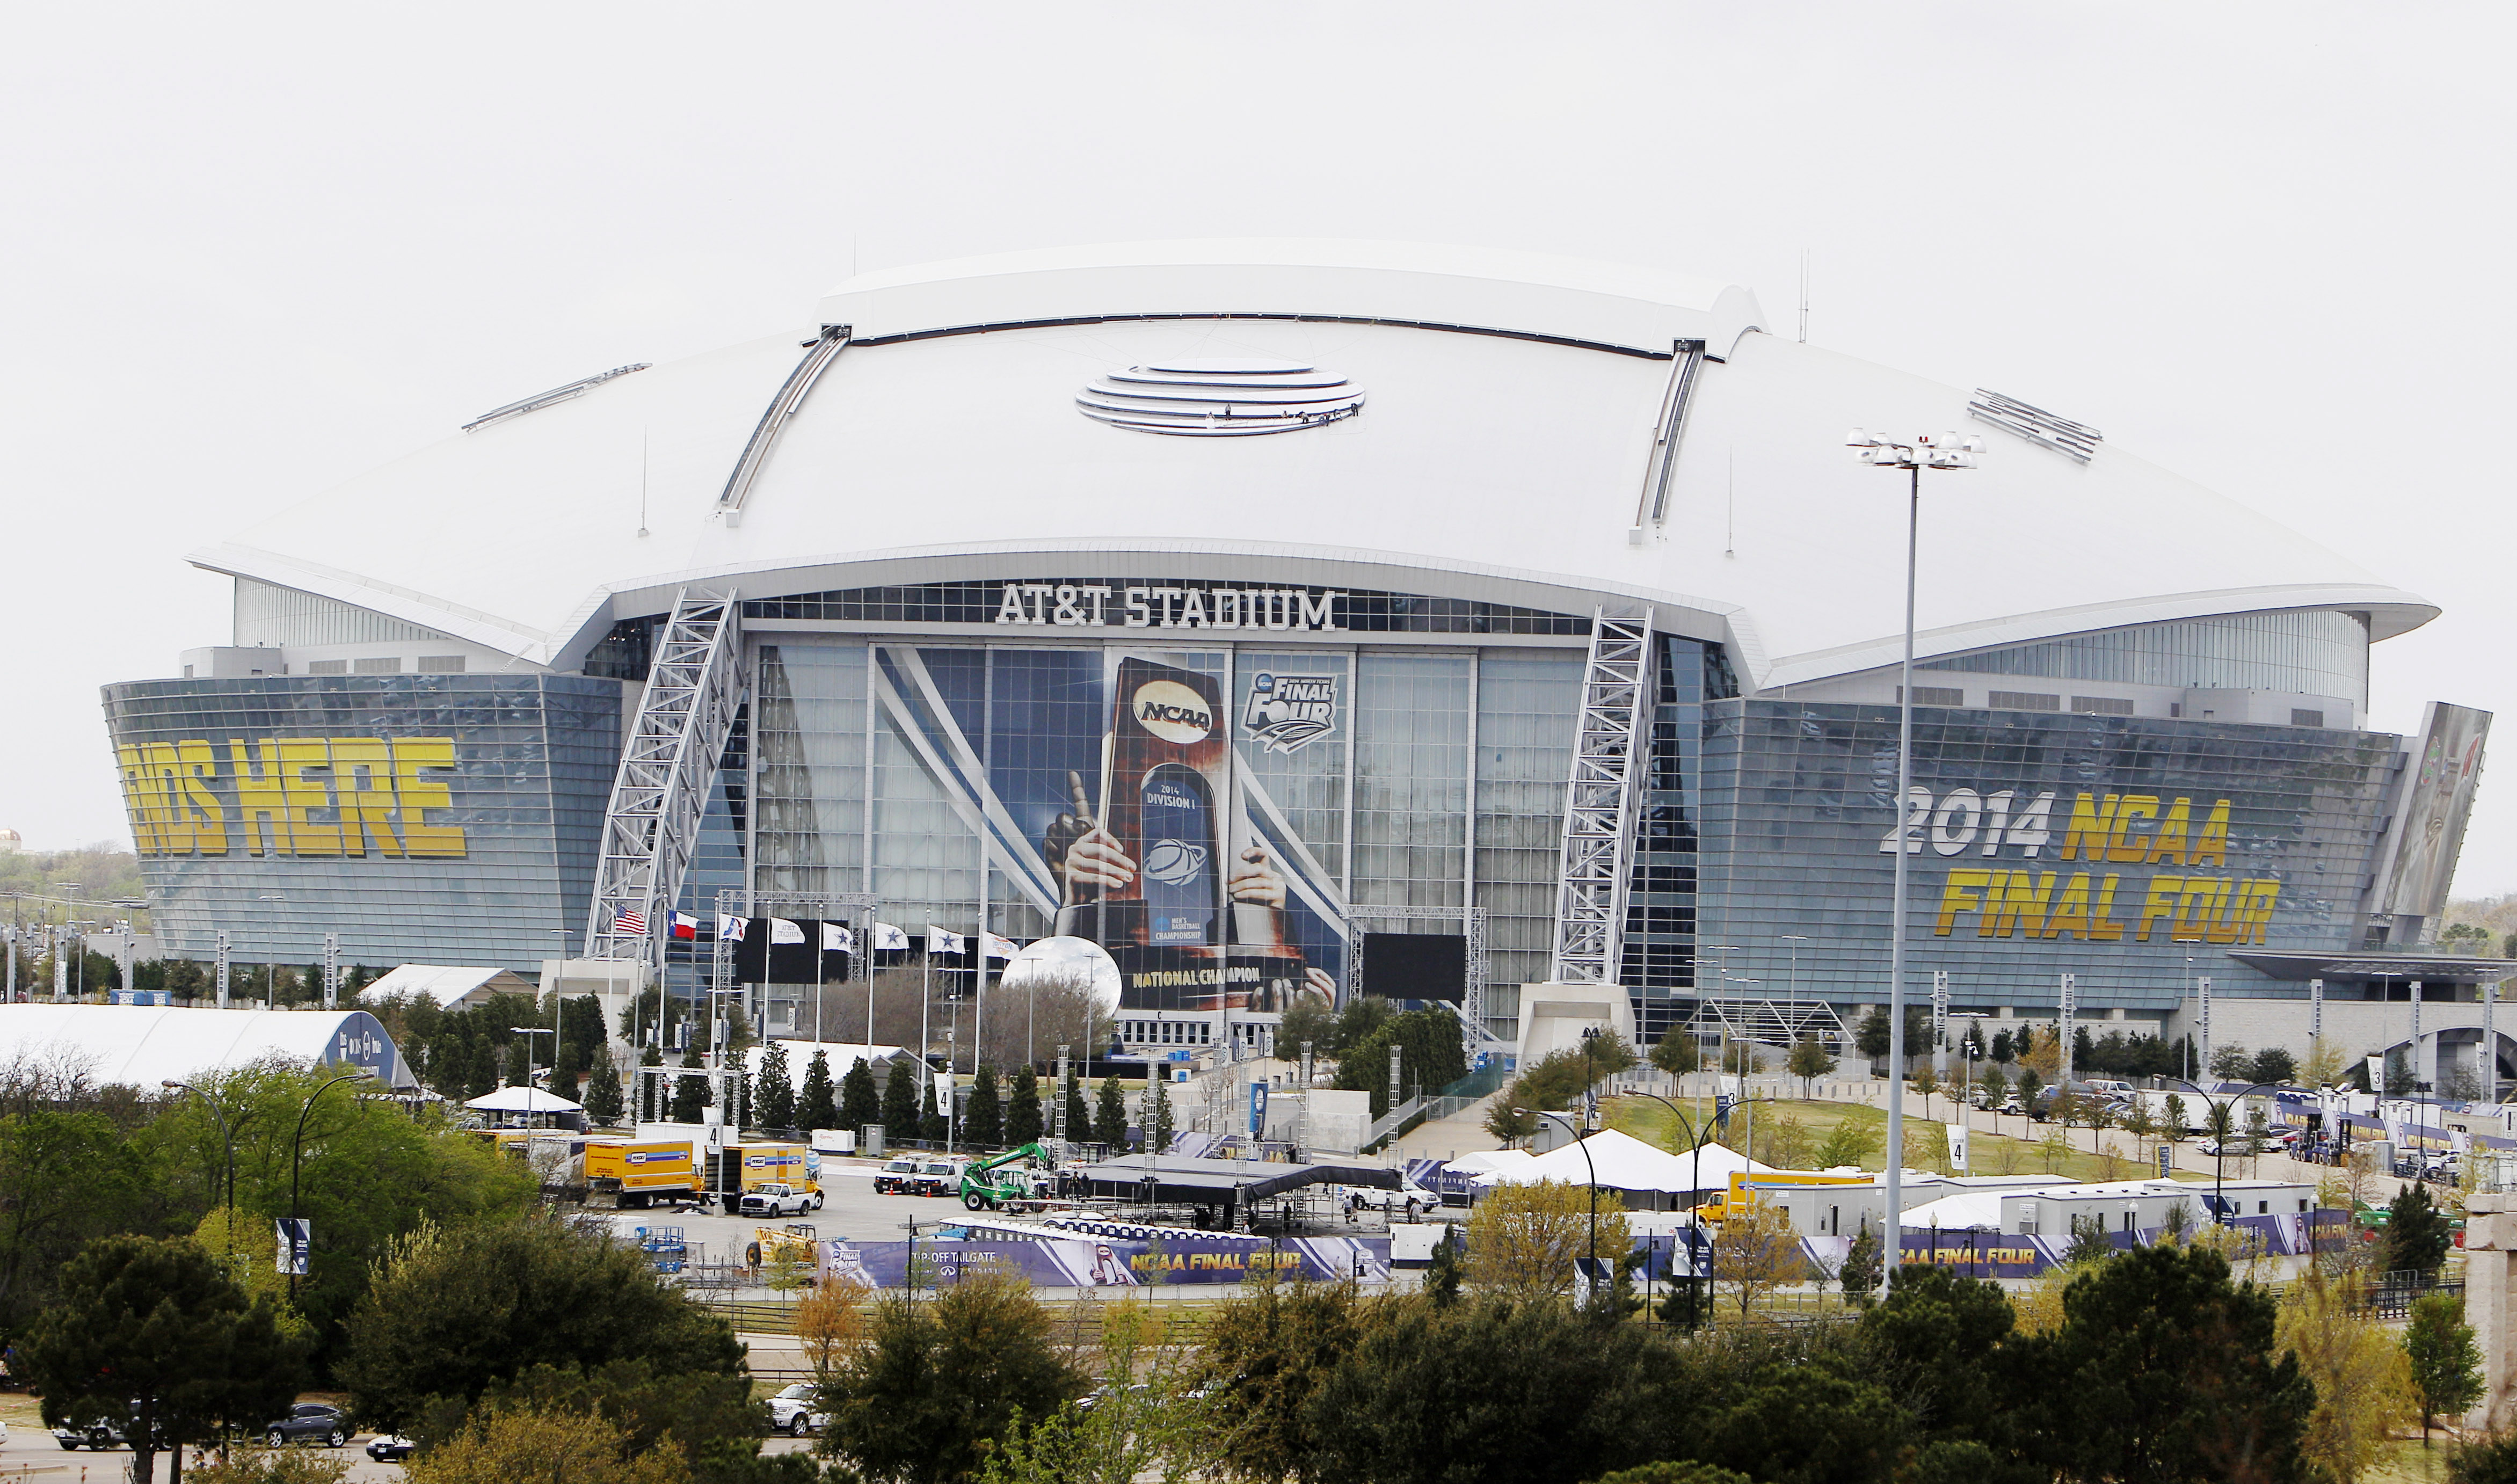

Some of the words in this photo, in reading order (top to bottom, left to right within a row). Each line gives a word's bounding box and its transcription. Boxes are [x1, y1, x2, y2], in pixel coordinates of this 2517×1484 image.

[995, 583, 1112, 627] AT&T
[1125, 586, 1336, 632] STADIUM
[1272, 678, 1332, 701] FINAL
[1140, 701, 1210, 732] NCAA
[1247, 693, 1329, 726] FOUR
[118, 739, 230, 857] ENDS
[229, 736, 468, 858] HERE
[1161, 784, 1179, 795] 2014
[1147, 792, 1190, 809] DIVISION
[1191, 799, 1196, 810] I
[1879, 785, 2057, 857] 2014
[2060, 792, 2231, 867] NCAA
[1933, 868, 2126, 941] FINAL
[2135, 874, 2281, 945] FOUR
[1155, 930, 1201, 940] CHAMPIONSHIP
[1133, 970, 1198, 988] NATIONAL
[1199, 967, 1260, 985] CHAMPION
[1158, 1011, 1161, 1020] C
[2375, 1072, 2380, 1085] 3
[941, 1092, 947, 1108] 4
[1729, 1093, 1735, 1106] 3
[710, 1128, 717, 1145] 4
[1954, 1144, 1961, 1160] 4
[839, 1252, 857, 1261] FINAL
[950, 1252, 996, 1263] TAILGATE
[1130, 1254, 1186, 1271] NCAA
[1188, 1253, 1245, 1270] FINAL
[1248, 1252, 1302, 1269] FOUR
[1934, 1248, 1983, 1264] FINAL
[1986, 1248, 2035, 1264] FOUR
